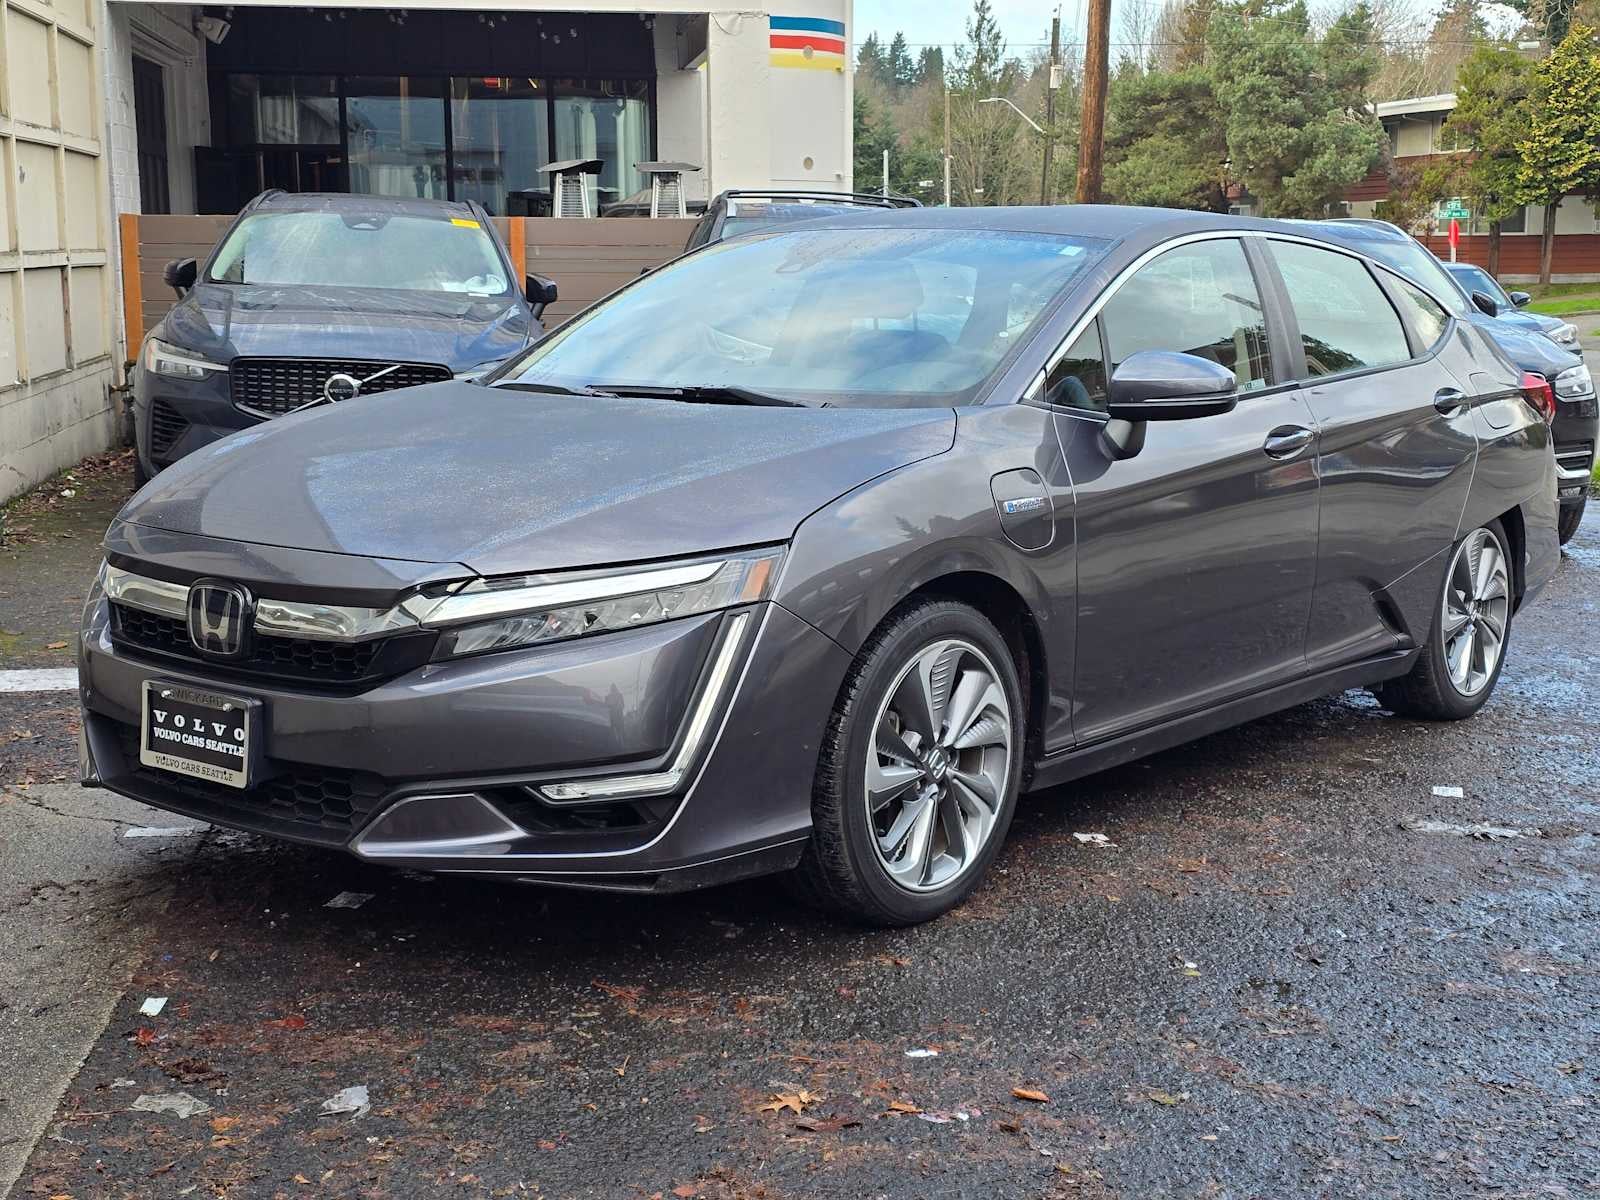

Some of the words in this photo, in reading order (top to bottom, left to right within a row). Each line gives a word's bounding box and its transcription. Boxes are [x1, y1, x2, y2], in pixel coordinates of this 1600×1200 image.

[153, 709, 245, 741] VOLVO
[153, 726, 181, 742] VOLVO
[182, 733, 205, 748] CARS
[206, 740, 245, 757] SEATTLE
[155, 755, 180, 769] VOLVO
[181, 761, 201, 774] CARS
[201, 766, 233, 782] SEATTLE
